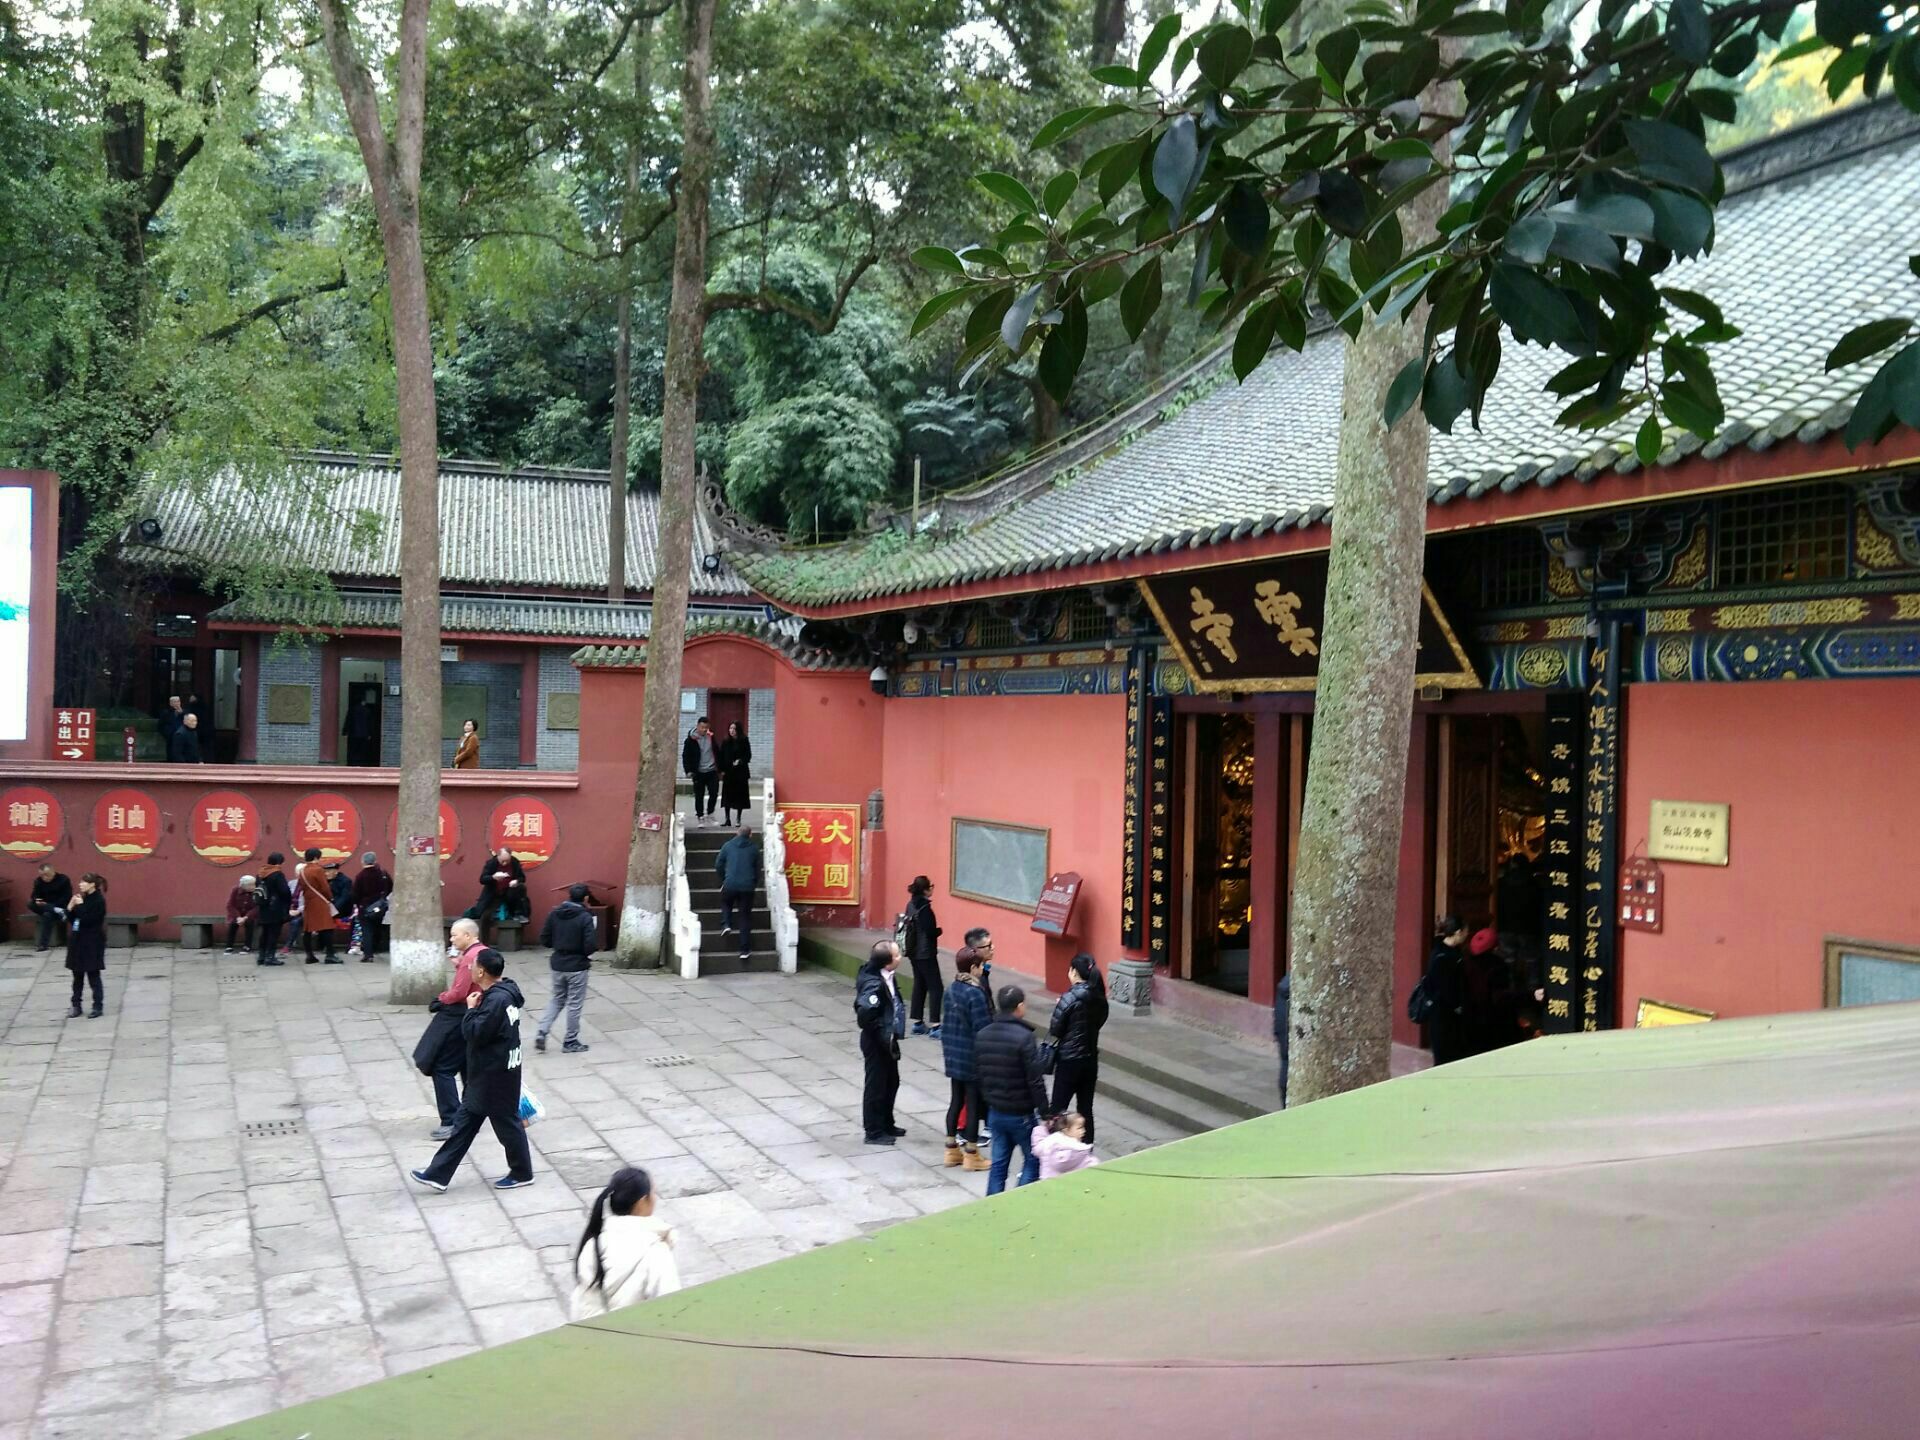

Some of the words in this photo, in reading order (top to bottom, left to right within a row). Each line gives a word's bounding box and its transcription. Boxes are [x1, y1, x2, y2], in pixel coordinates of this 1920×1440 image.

[58, 711, 91, 725] 东门
[58, 726, 91, 740] 出口
[9, 802, 49, 827] 和谐
[108, 804, 146, 829] 自由
[205, 807, 247, 833] 平等
[305, 809, 345, 833] 公正
[502, 812, 543, 837] 爱国
